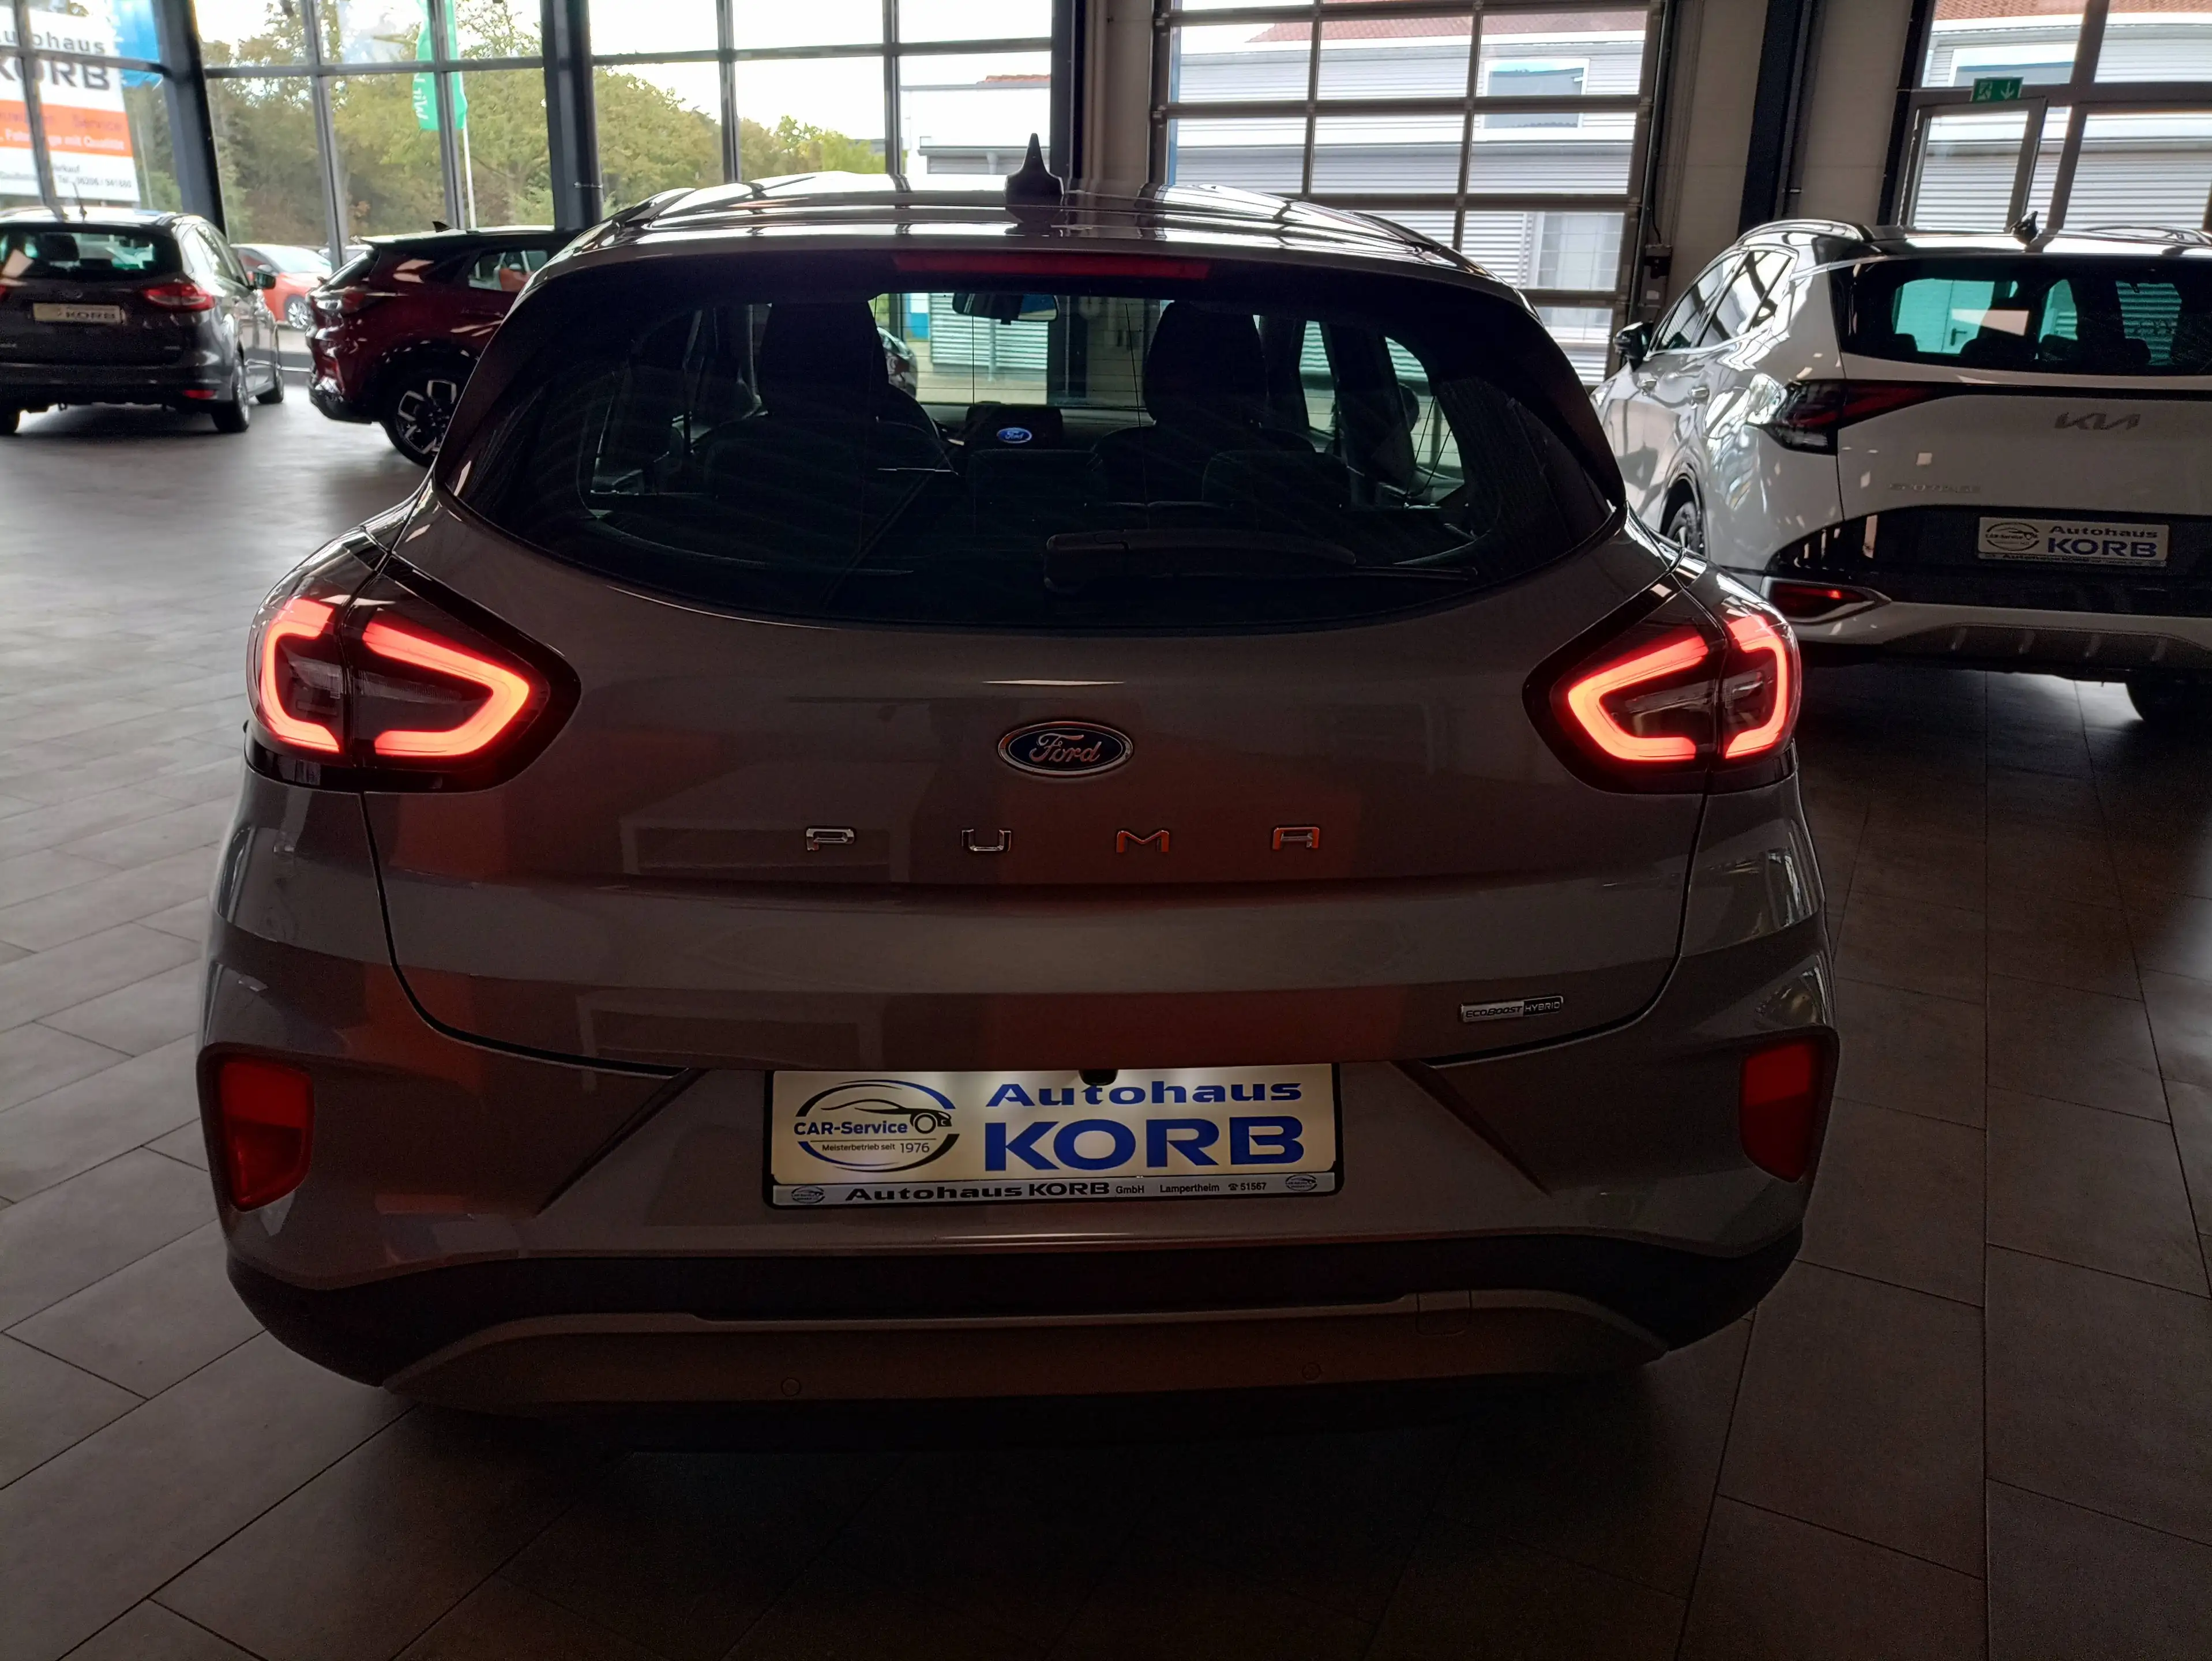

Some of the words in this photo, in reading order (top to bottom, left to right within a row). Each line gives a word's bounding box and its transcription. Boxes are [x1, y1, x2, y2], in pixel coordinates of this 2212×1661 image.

[2053, 411, 2141, 430] KIA
[2048, 525, 2158, 539] Autohaus
[2047, 538, 2158, 558] KORB
[1029, 732, 1102, 762] Ford
[806, 825, 1320, 853] PUMA
[1466, 1006, 1523, 1018] ECOBOOST
[1524, 1001, 1560, 1012] HYBRID
[985, 1081, 1302, 1107] Autohaus
[794, 1121, 908, 1135] CAR-Service
[822, 1143, 880, 1152] Meisterbetrieb
[881, 1143, 895, 1151] seit
[900, 1143, 930, 1153] 1976
[985, 1115, 1304, 1171] KORB
[846, 1186, 1023, 1201] Autohaus
[1028, 1182, 1110, 1197] KORB
[1116, 1185, 1145, 1194] GmbH
[1160, 1183, 1220, 1193] Lampertheim
[1240, 1182, 1267, 1191] 51567
